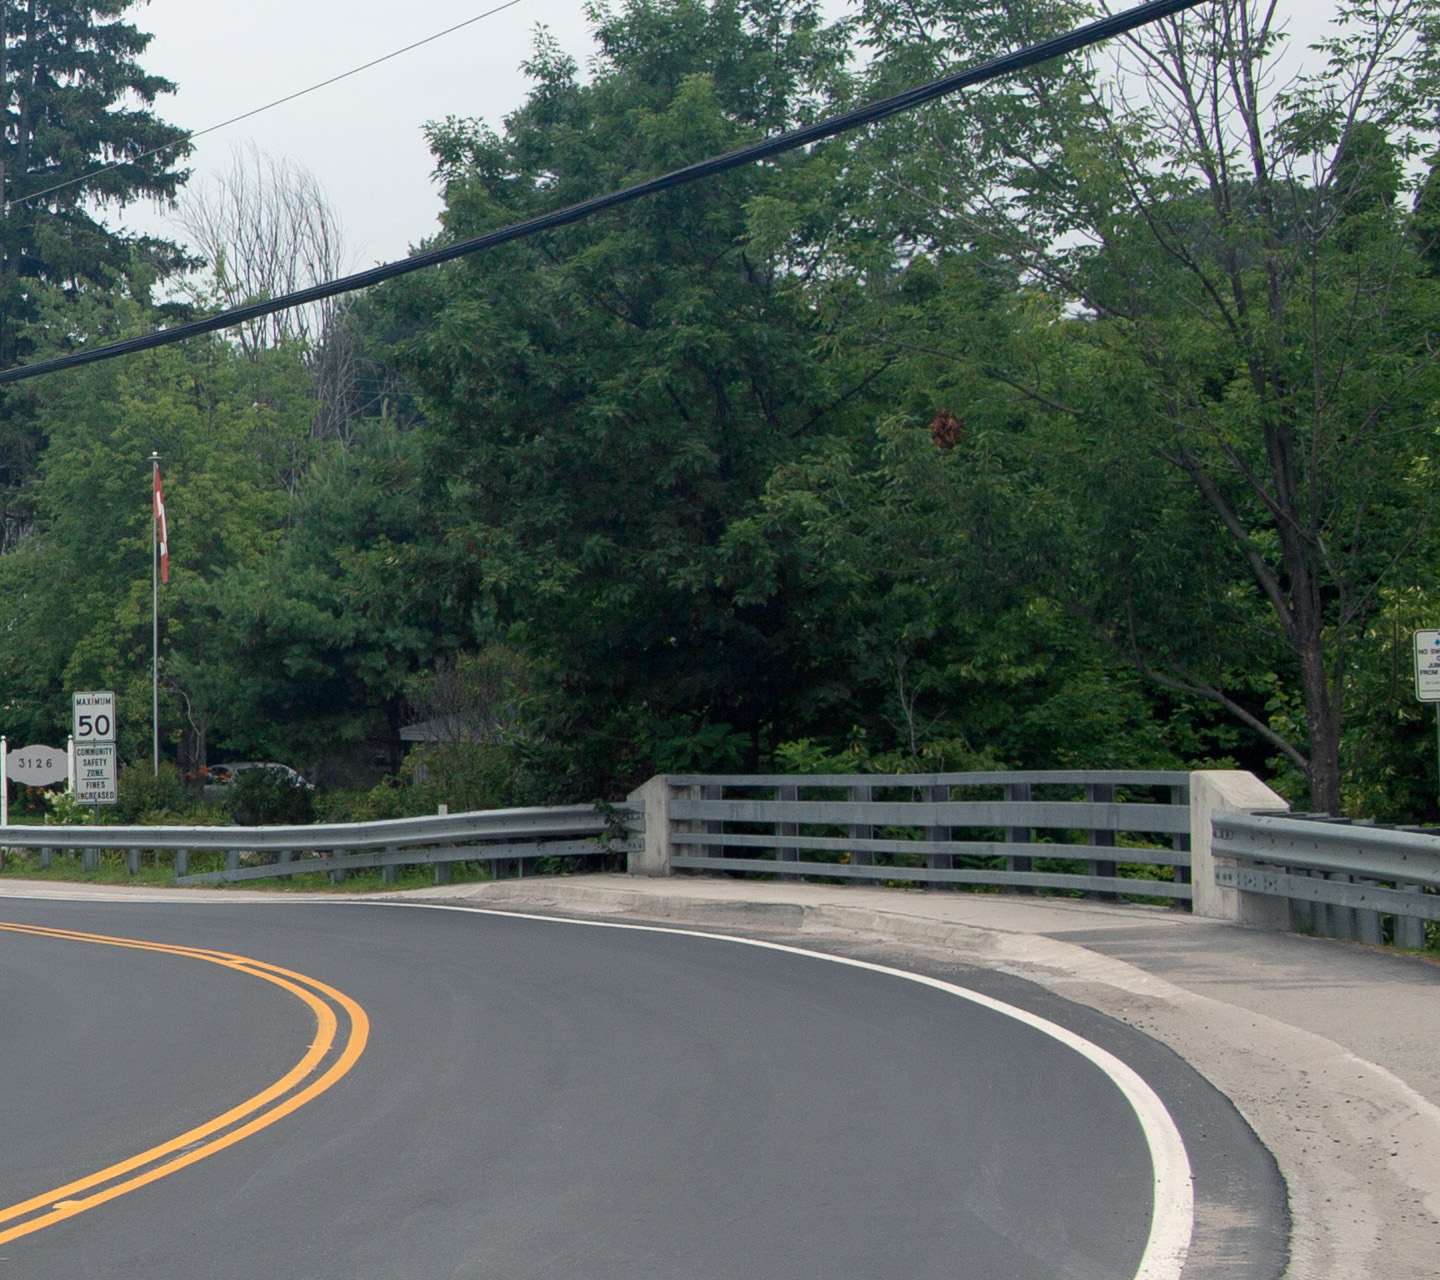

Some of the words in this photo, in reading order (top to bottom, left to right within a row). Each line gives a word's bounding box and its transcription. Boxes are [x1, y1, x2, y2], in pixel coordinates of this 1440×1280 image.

[76, 697, 111, 706] MAXIMUM
[78, 714, 111, 737] 50
[76, 747, 113, 756] COMMUNITY
[18, 758, 53, 769] 3126
[82, 758, 107, 767] SAFETY
[86, 768, 104, 777] ZONE
[85, 780, 106, 789] FINES
[77, 791, 114, 800] INCREASED
